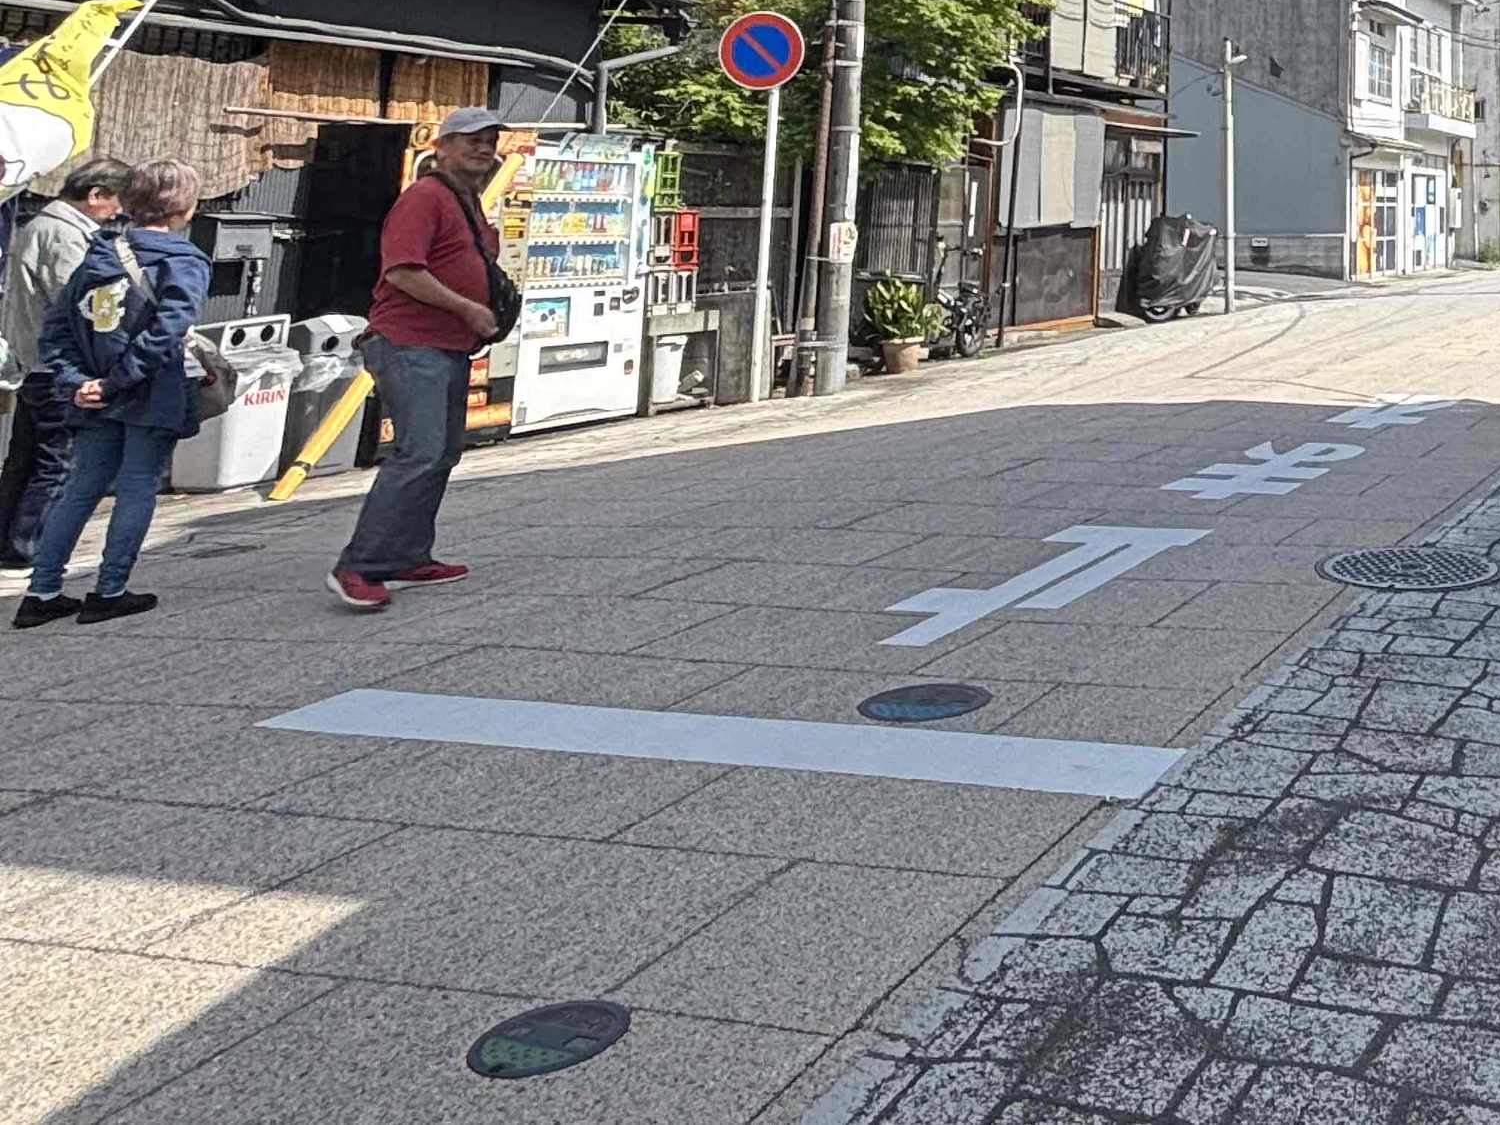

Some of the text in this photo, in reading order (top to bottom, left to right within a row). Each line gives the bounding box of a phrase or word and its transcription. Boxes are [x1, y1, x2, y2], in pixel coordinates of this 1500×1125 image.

[243, 388, 286, 407] KIRIN
[877, 393, 1461, 647] 止まれ
